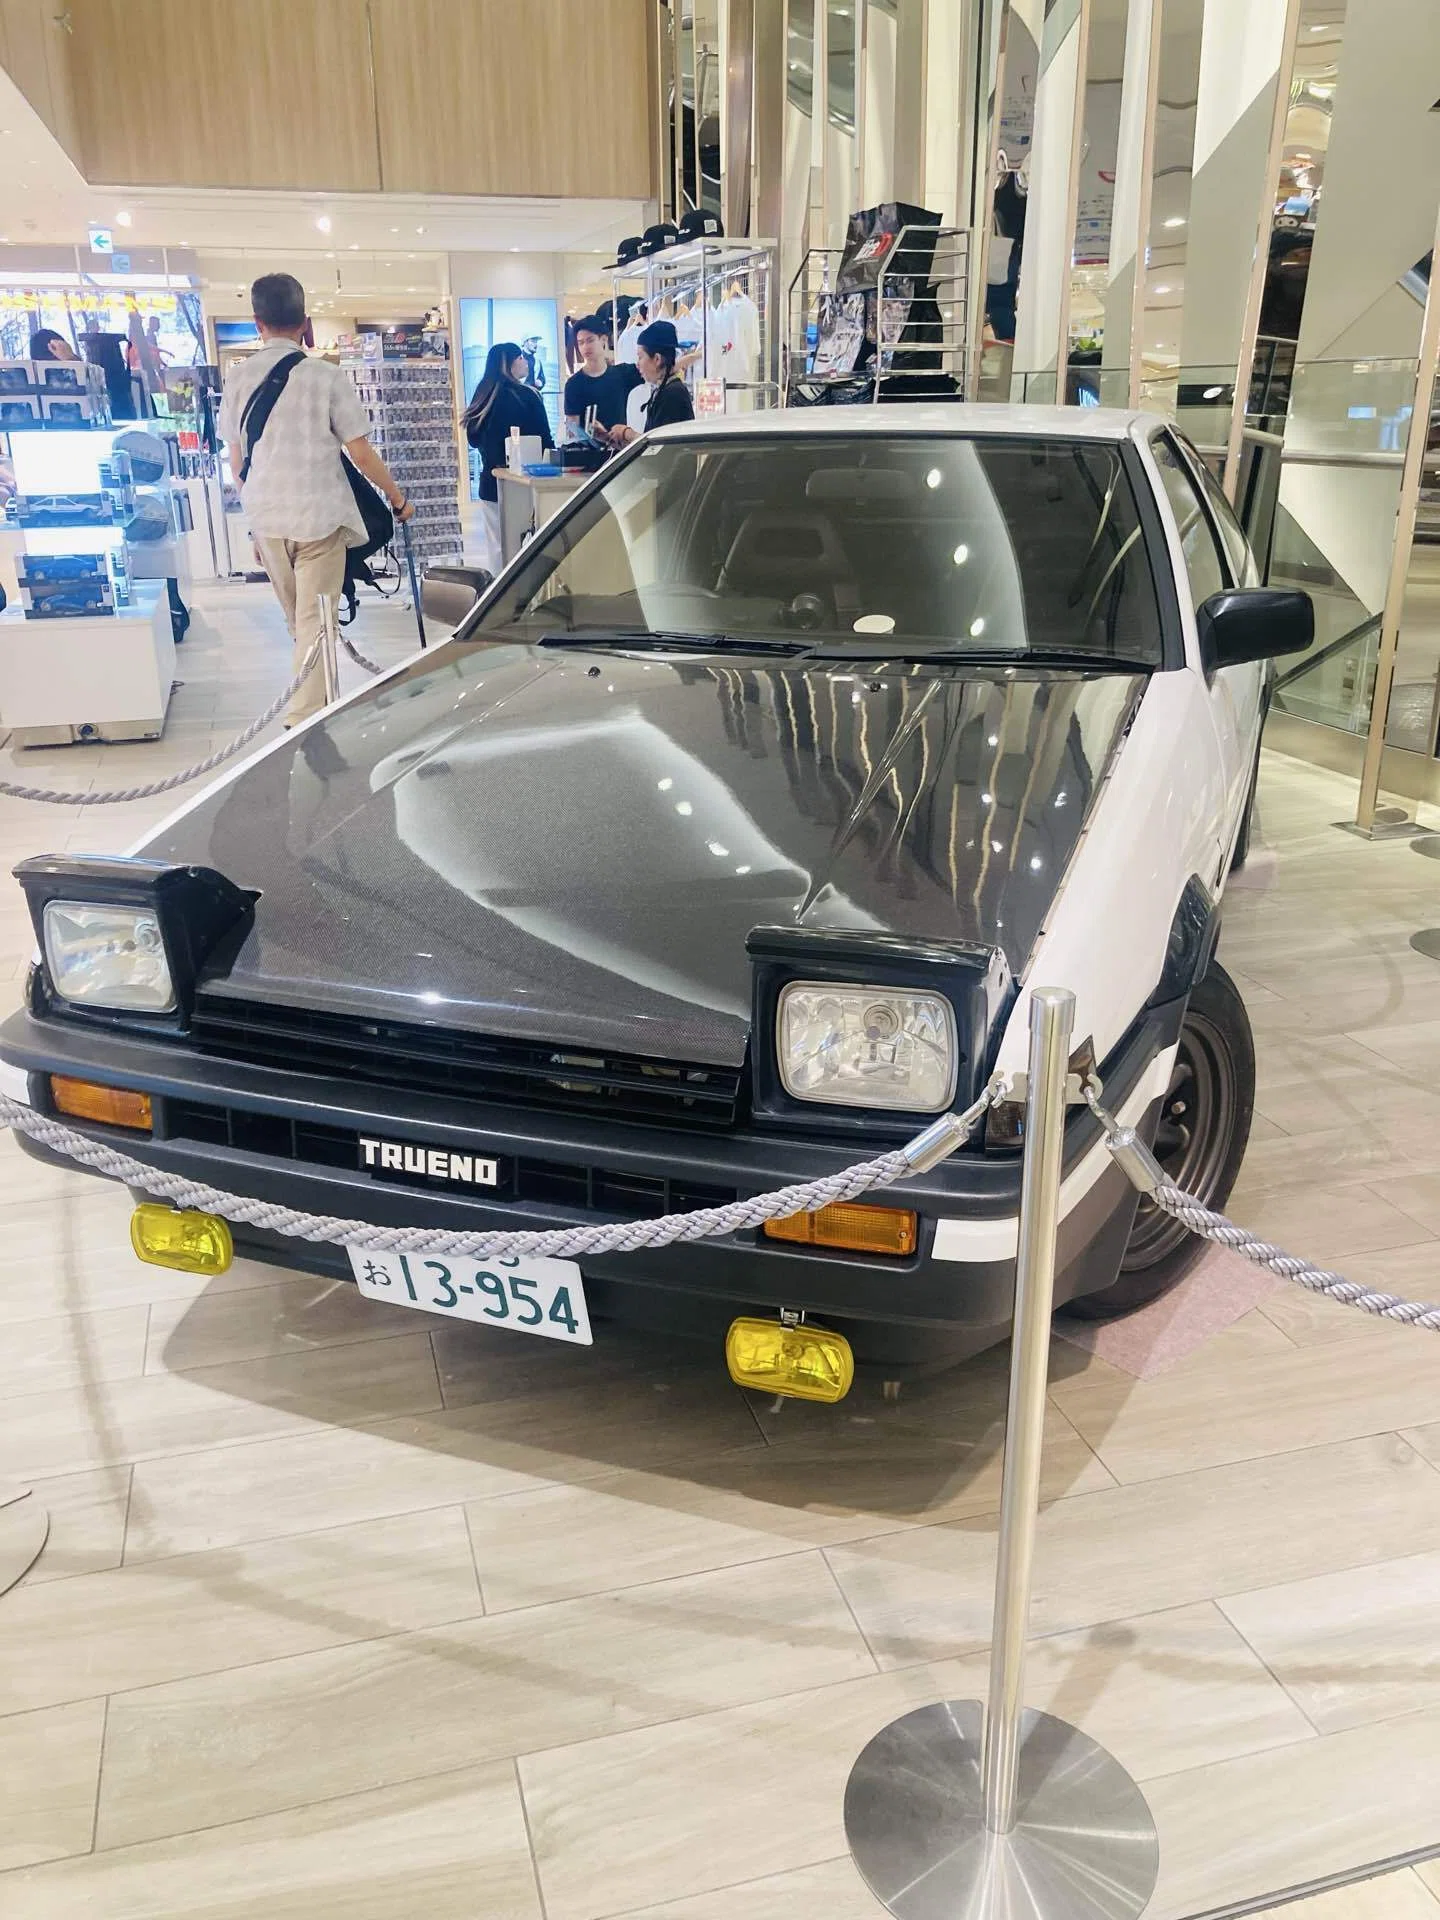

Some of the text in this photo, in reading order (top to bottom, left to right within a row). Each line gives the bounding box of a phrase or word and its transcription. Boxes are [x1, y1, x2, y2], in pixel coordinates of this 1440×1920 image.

[359, 1138, 497, 1186] TRUENO
[363, 1255, 579, 1334] お 13-954
